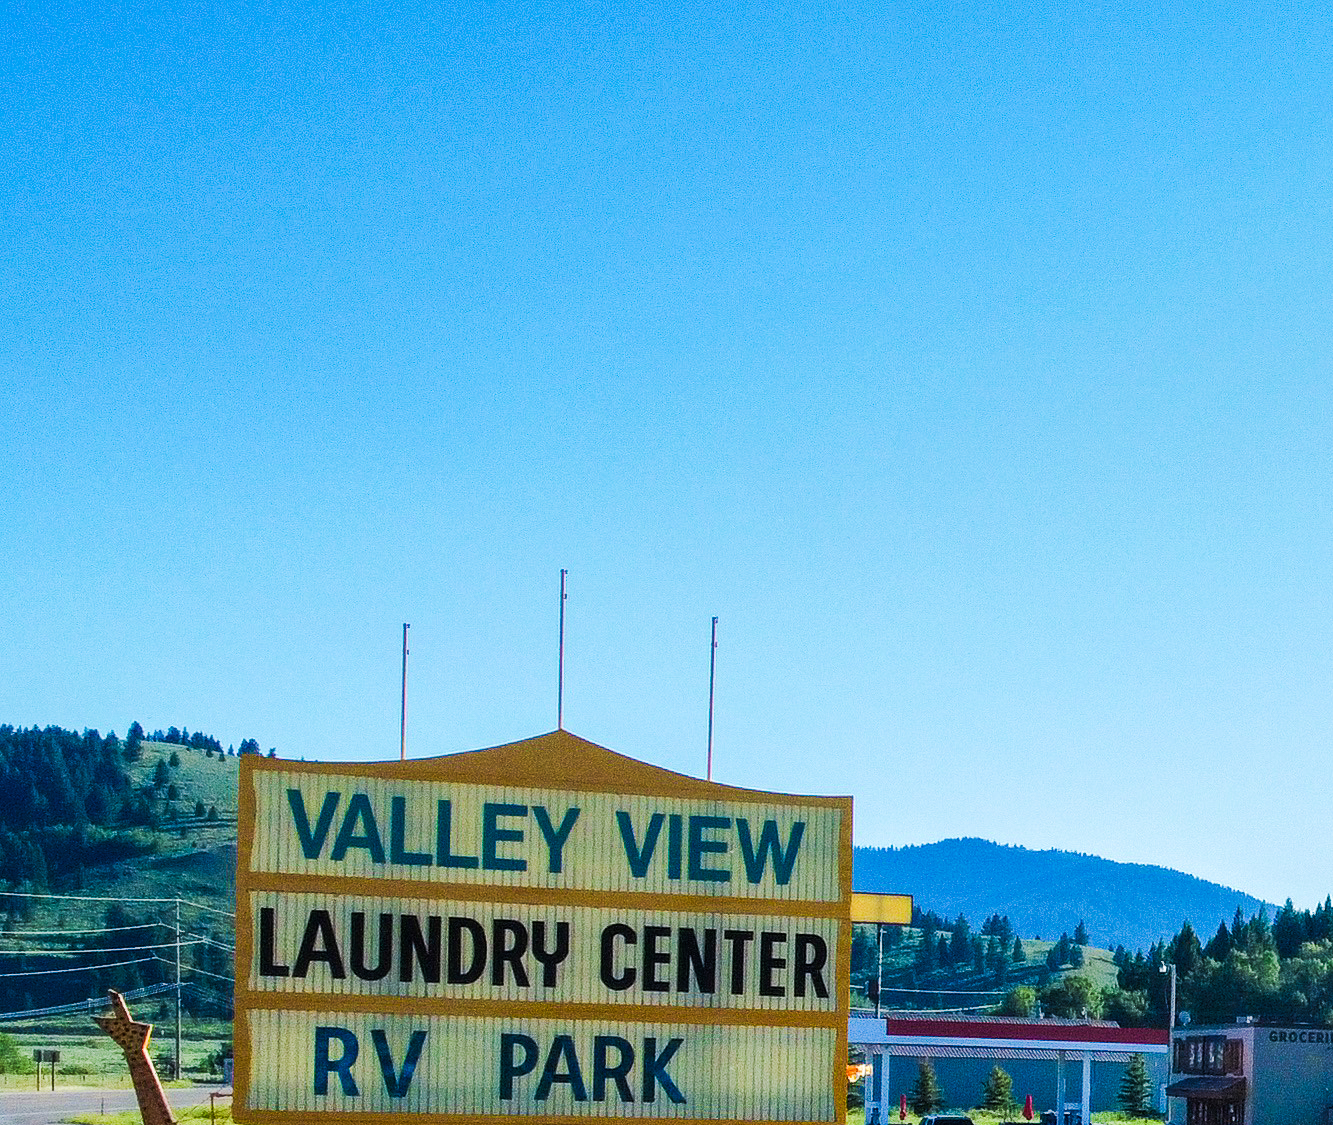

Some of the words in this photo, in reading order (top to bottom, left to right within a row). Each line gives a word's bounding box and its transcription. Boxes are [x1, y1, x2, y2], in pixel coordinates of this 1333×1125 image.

[287, 788, 581, 874] VALLEY
[616, 805, 805, 886] VIEW
[259, 906, 571, 989] LAUNDRY
[600, 922, 829, 999] CENTER
[313, 1026, 428, 1099] RV
[499, 1032, 687, 1105] PARK
